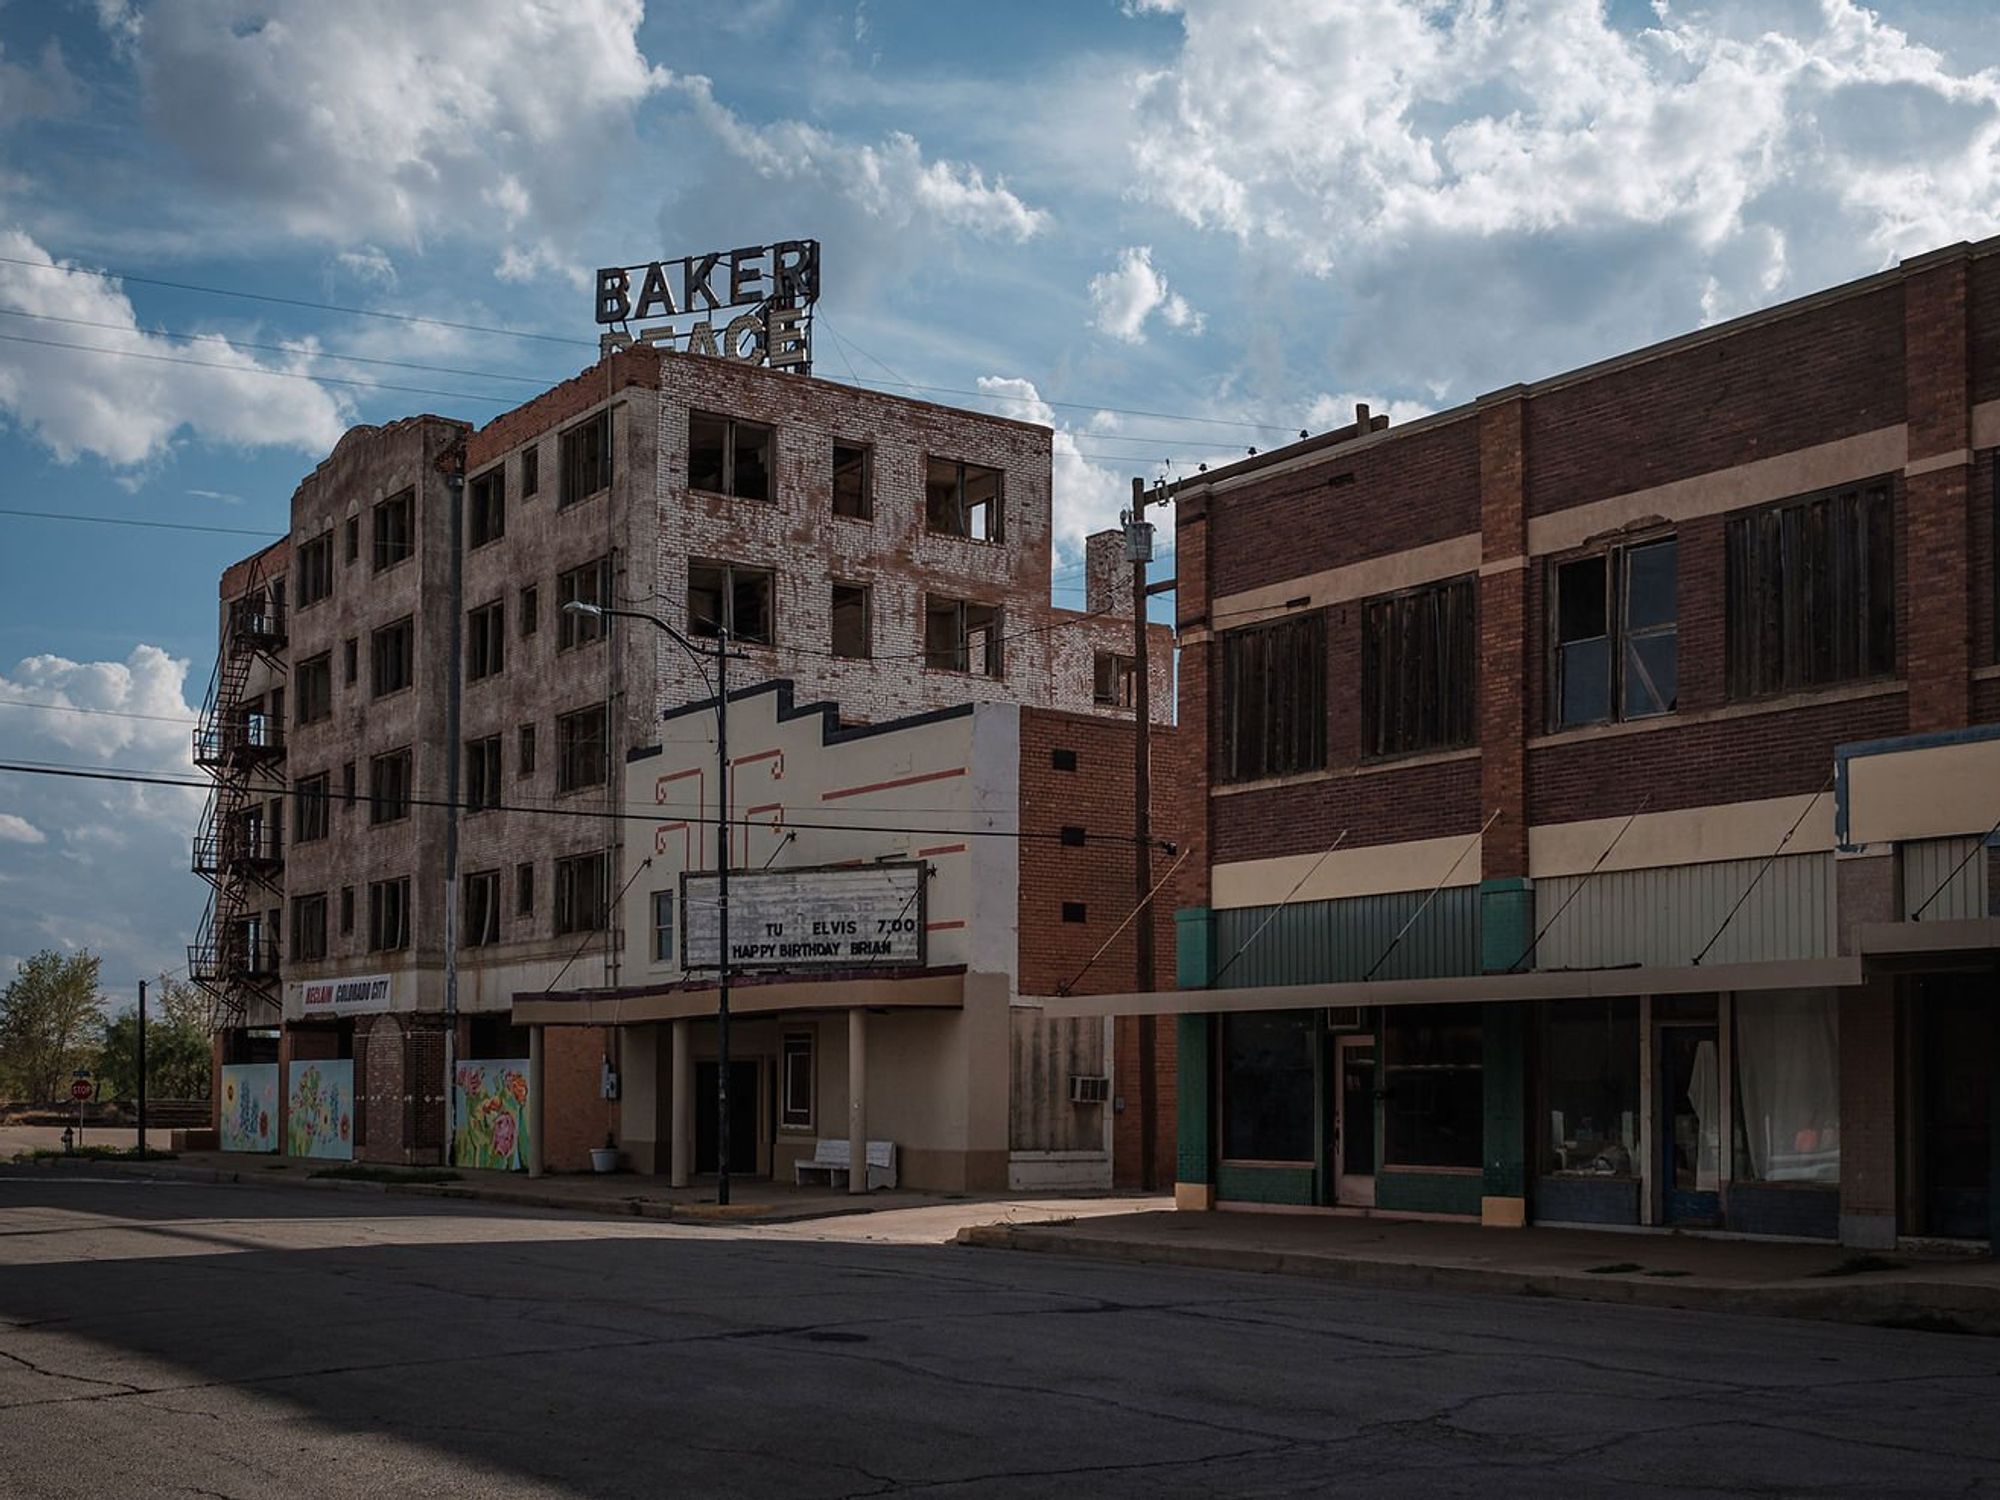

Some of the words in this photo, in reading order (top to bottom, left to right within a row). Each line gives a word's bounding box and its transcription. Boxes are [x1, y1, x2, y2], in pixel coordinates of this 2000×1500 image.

[596, 240, 811, 323] BAKER
[766, 923, 783, 936] TU
[812, 921, 857, 935] ELVIS
[733, 943, 775, 958] HAPPY
[780, 942, 840, 957] BIRTHDAY
[851, 941, 891, 955] BRIAN
[336, 982, 372, 1003] COLORADO
[371, 980, 389, 1000] CITY
[73, 1085, 90, 1094] STOP
